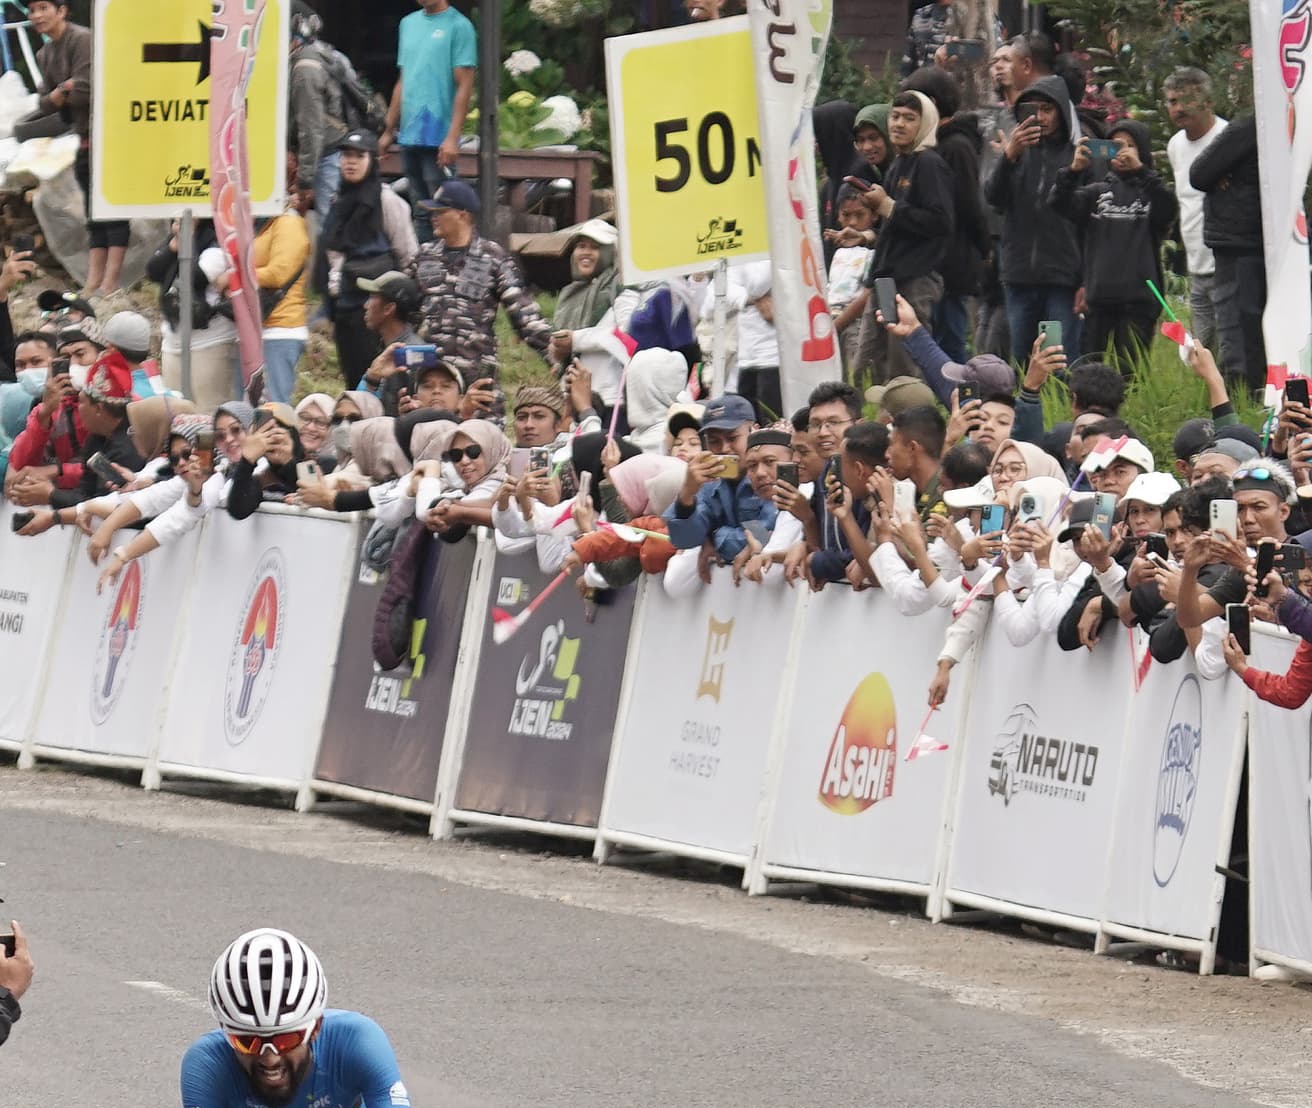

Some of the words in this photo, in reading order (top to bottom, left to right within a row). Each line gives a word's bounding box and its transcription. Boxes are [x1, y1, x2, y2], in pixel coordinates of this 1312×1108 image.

[654, 111, 735, 193] 50
[365, 675, 402, 714] IJEN
[508, 698, 554, 736] IJEN
[681, 719, 721, 748] GRAND
[1016, 733, 1099, 787] NARUTO
